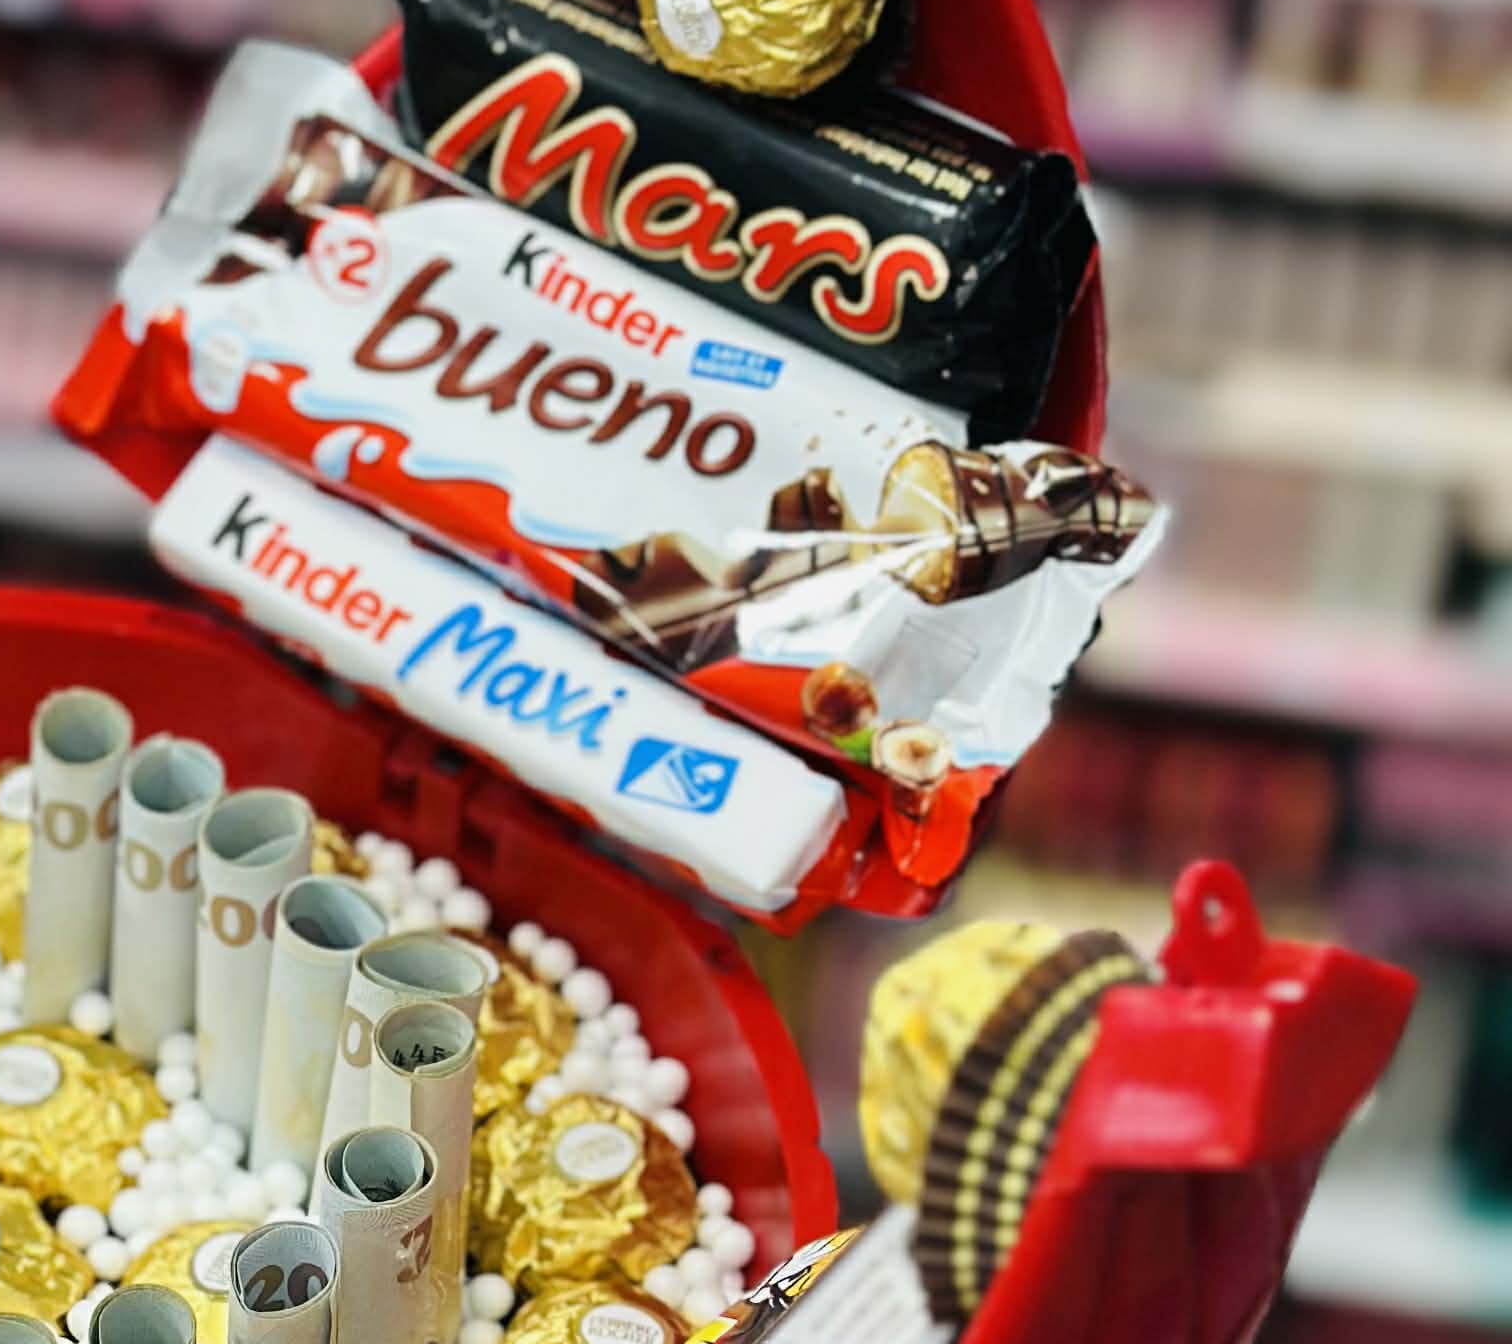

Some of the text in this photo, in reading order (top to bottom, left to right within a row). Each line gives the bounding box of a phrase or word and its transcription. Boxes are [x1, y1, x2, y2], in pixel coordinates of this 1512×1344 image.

[425, 53, 949, 343] Mars
[352, 259, 758, 477] bueno
[502, 232, 684, 357] Kinder
[213, 493, 411, 646] Kinder
[396, 603, 627, 753] Maxi
